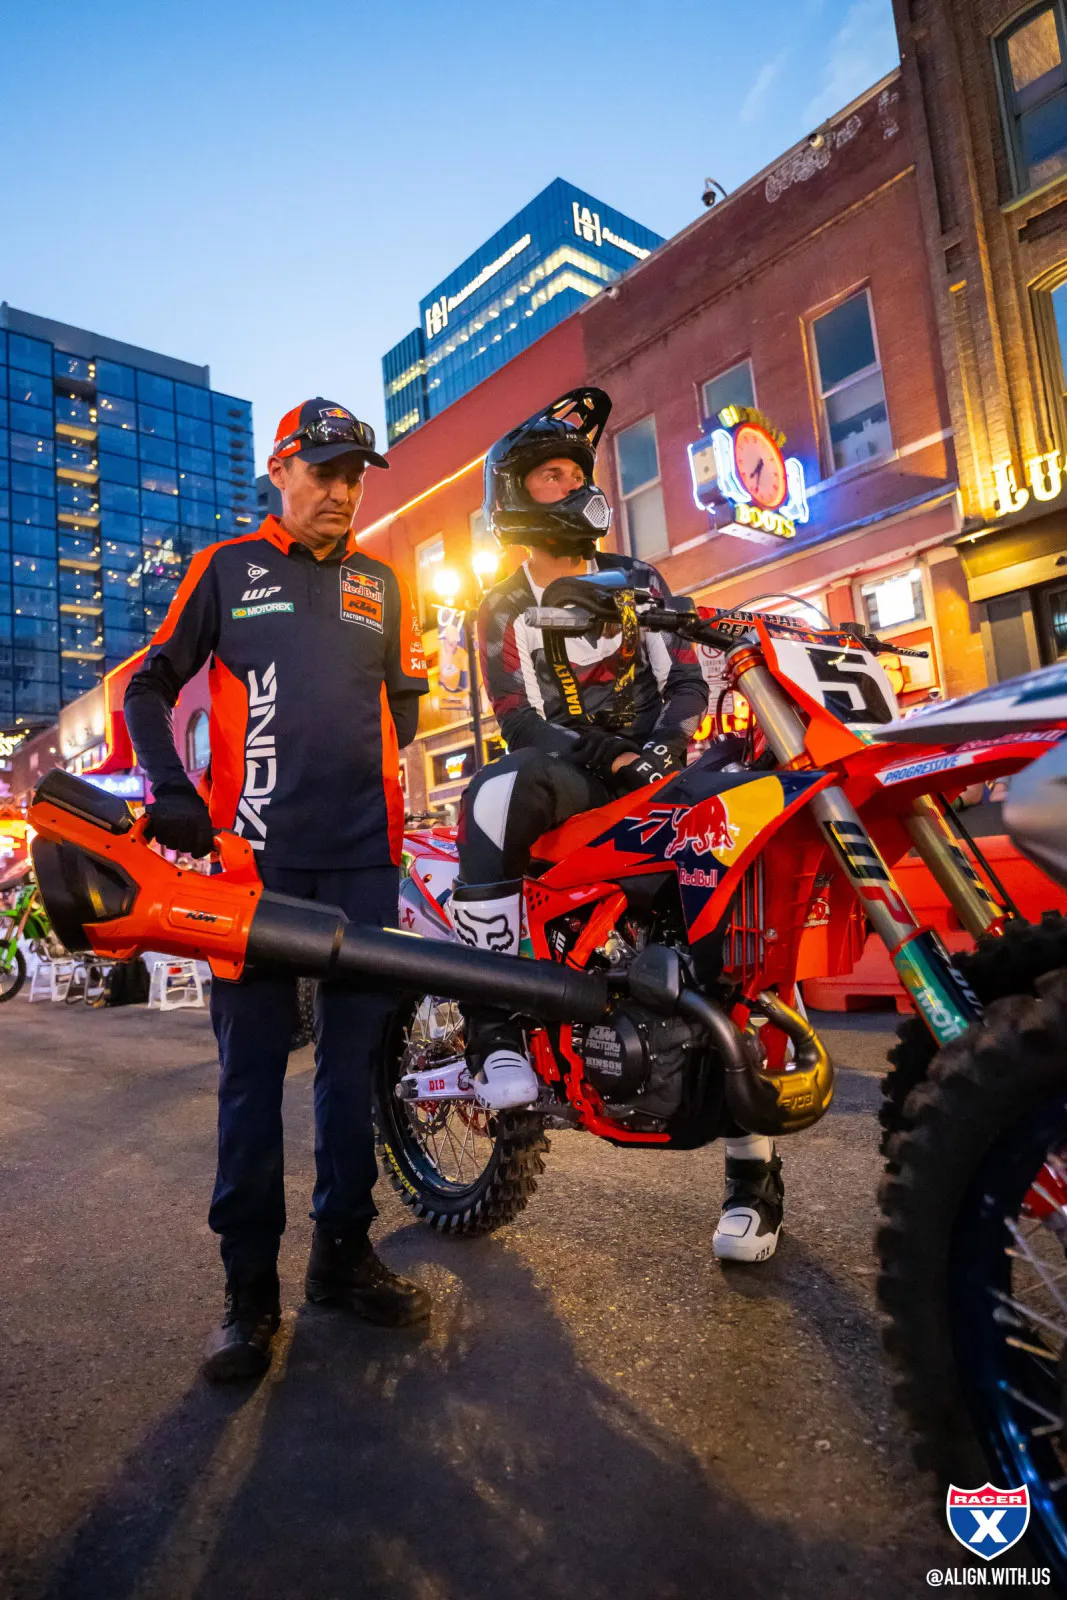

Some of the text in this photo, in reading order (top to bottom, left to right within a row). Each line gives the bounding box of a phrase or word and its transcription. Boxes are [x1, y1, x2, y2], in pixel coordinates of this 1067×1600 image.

[736, 503, 796, 538] BOOTS
[241, 586, 282, 602] WP
[342, 582, 382, 603] Red Bull
[247, 602, 292, 616] MOTOREX
[348, 600, 377, 615] KTM
[343, 612, 382, 630] FACTORY RACING
[553, 663, 583, 715] OAKLEY
[805, 647, 893, 725] 5
[233, 661, 278, 851] RACING
[643, 741, 673, 769] FOX
[883, 755, 960, 784] PROGRESSIVE
[679, 868, 718, 888] Red Bull
[185, 910, 218, 923] KTM
[588, 1025, 617, 1042] KTM
[585, 1039, 621, 1053] FACTORY
[428, 1079, 445, 1091] DID
[384, 1143, 417, 1195] DUNLOP
[755, 1246, 770, 1261] FOX
